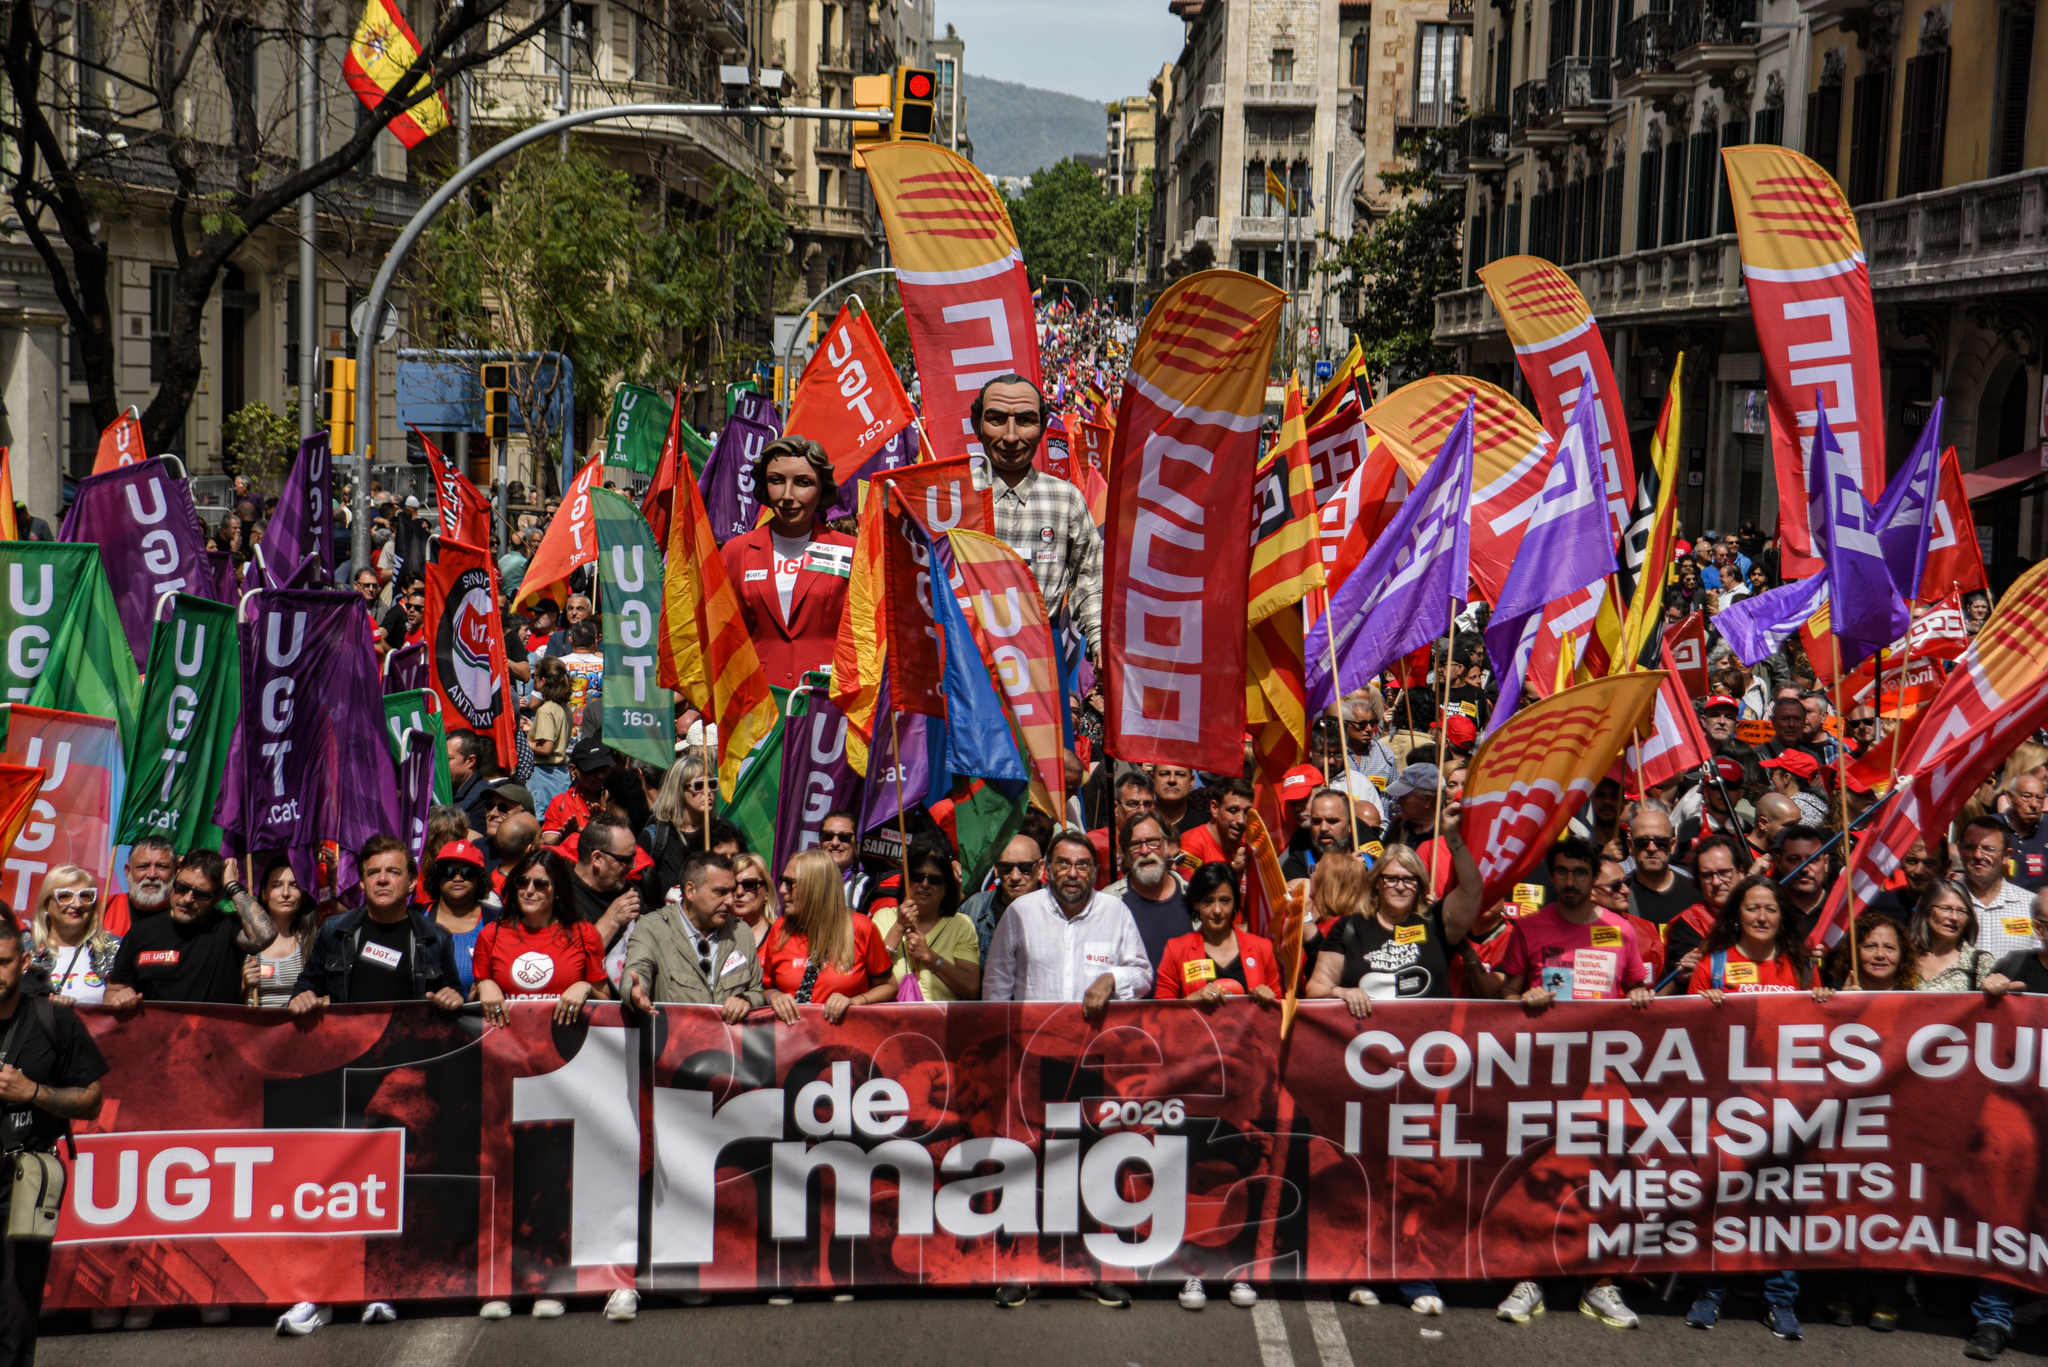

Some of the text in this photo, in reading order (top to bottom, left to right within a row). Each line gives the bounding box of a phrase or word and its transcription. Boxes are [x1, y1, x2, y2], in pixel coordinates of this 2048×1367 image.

[614, 391, 638, 451] UGT
[1121, 430, 1215, 742] CCOO
[161, 618, 206, 803] UGT
[261, 611, 307, 798] UGT
[4, 737, 72, 910] UGT
[138, 805, 181, 831] .cat
[268, 800, 300, 825] .cat
[1344, 1022, 2048, 1089] CONTRA LES GU
[794, 1060, 910, 1137] de
[1099, 1098, 1185, 1129] 2026
[1344, 1094, 1892, 1158] I EL FEIXISME
[512, 1026, 784, 1266] 1r
[74, 1146, 386, 1224] UGT.cat
[770, 1101, 1188, 1267] maig
[1588, 1158, 1923, 1208] MÉS DRETS I
[1587, 1212, 1699, 1259] MÉS
